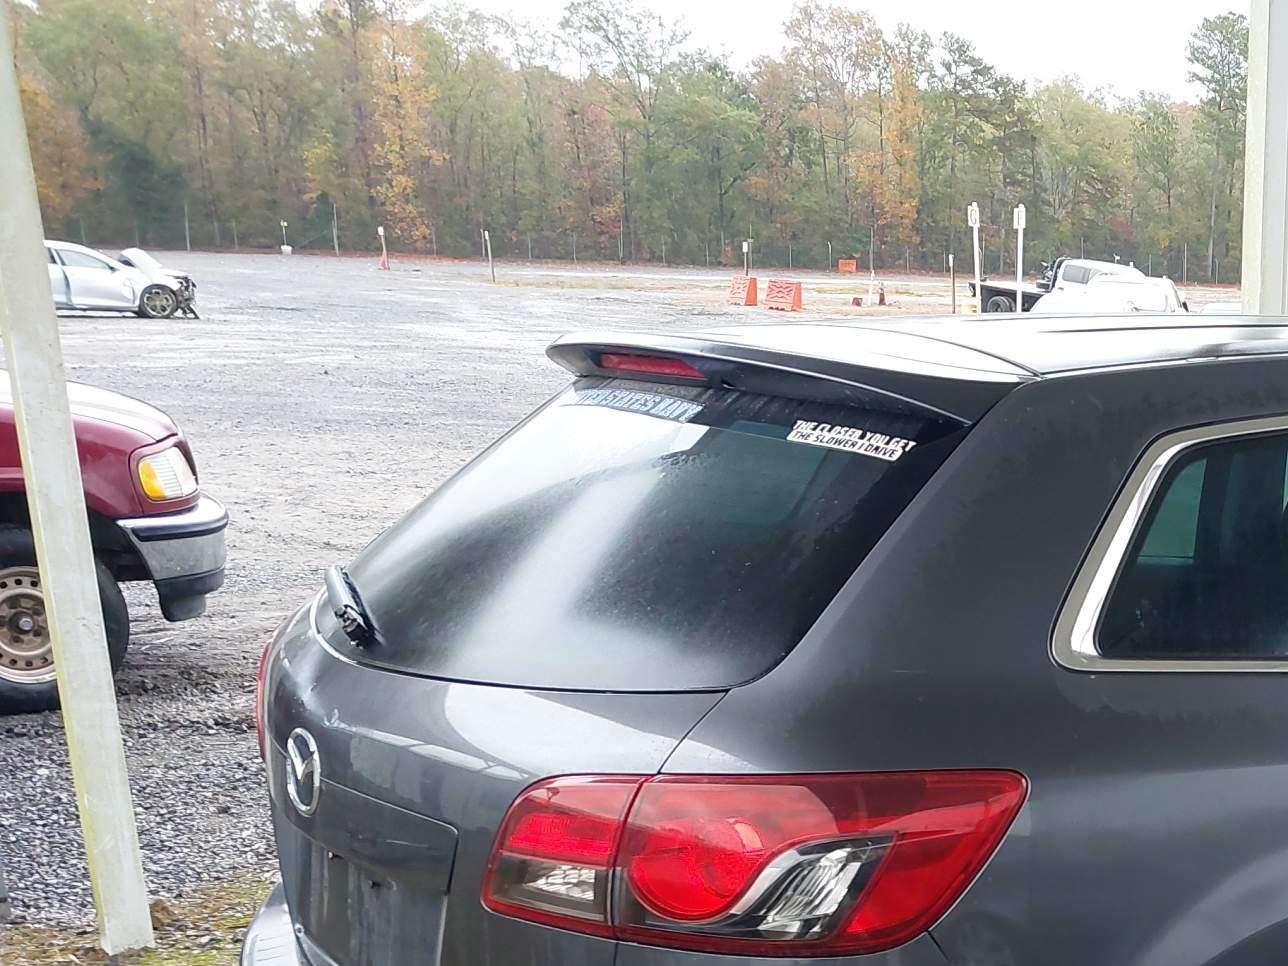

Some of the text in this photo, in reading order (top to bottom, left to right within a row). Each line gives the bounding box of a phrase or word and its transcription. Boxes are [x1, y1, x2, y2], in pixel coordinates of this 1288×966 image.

[792, 431, 813, 441] THE
[814, 434, 858, 449] SLOWER
[864, 443, 899, 458] DRIVE
[793, 420, 917, 452] THE CLOSER YOU GET
